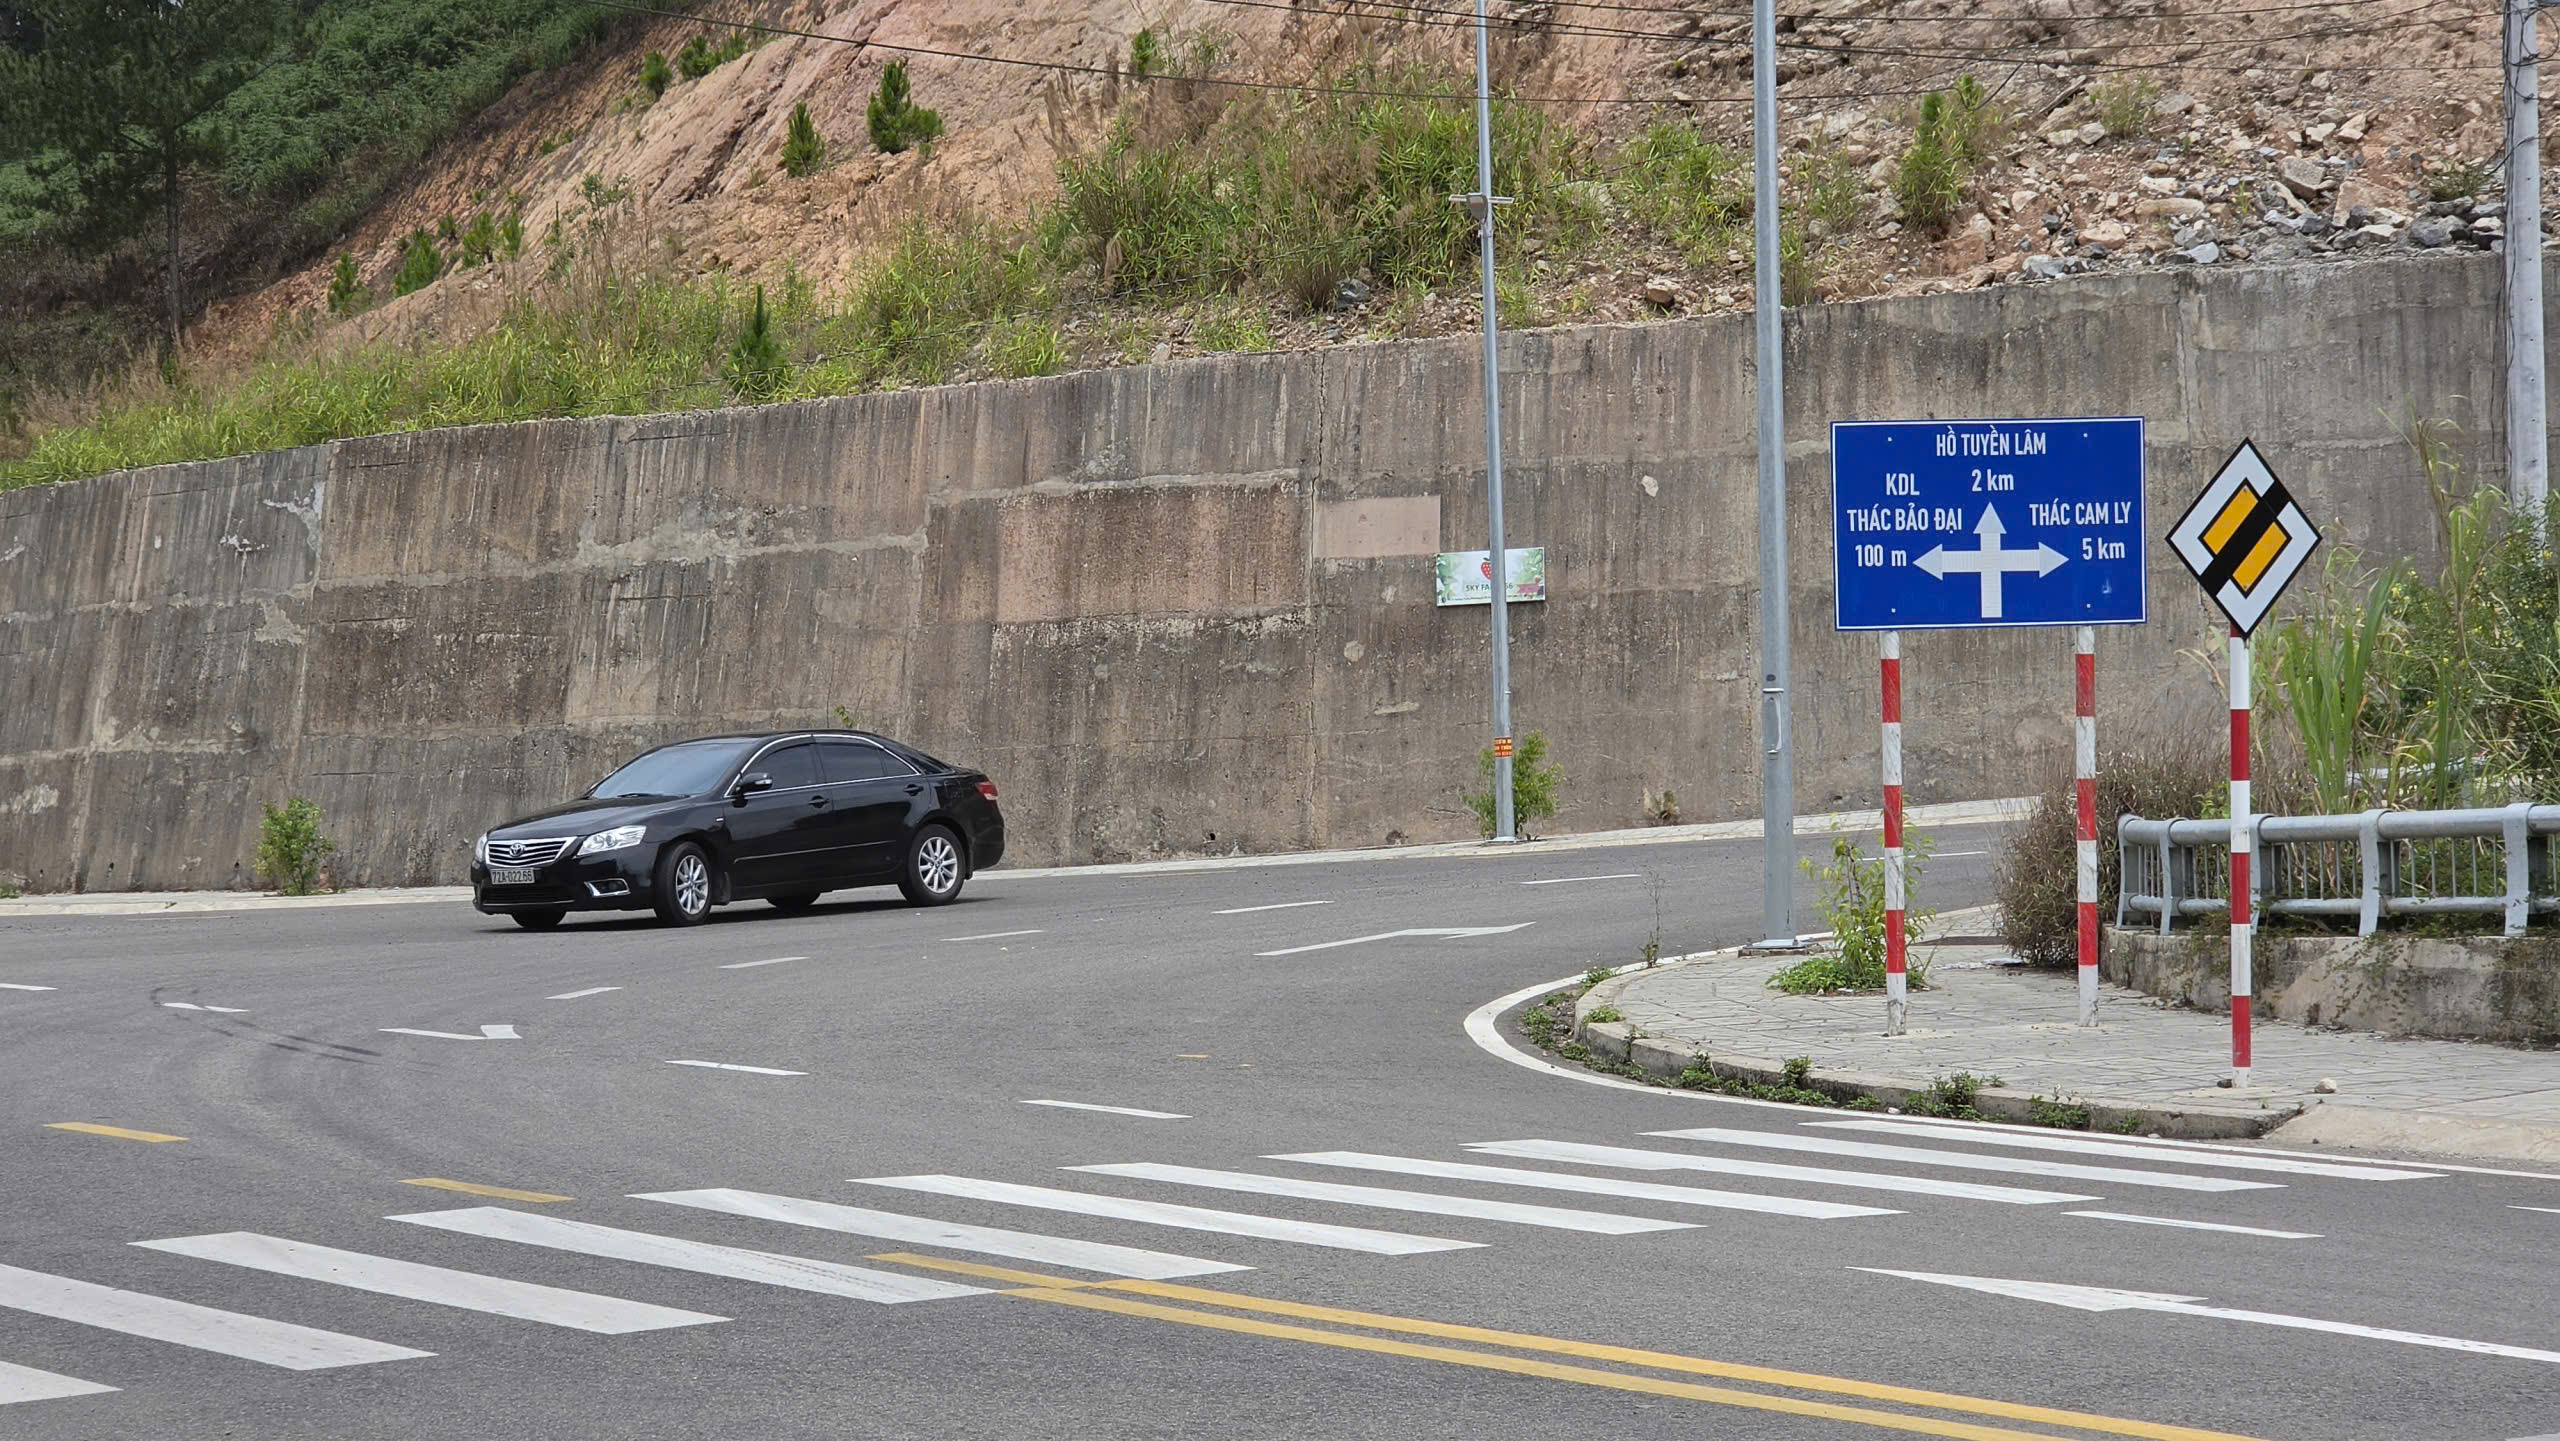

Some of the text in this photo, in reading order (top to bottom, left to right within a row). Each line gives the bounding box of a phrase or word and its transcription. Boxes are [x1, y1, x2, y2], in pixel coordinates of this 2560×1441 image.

[1936, 425, 2046, 457] HỒ TUYỀN LÂM
[1886, 473, 1920, 496] KDL
[1971, 469, 2014, 492] 2 km
[1847, 503, 1962, 534] THÁC BẢO ĐẠI
[2029, 498, 2131, 526] THÁC CAM LY
[1855, 544, 1907, 567] 100 m
[2082, 537, 2126, 560] 5 km
[1466, 584, 1480, 592] SKY
